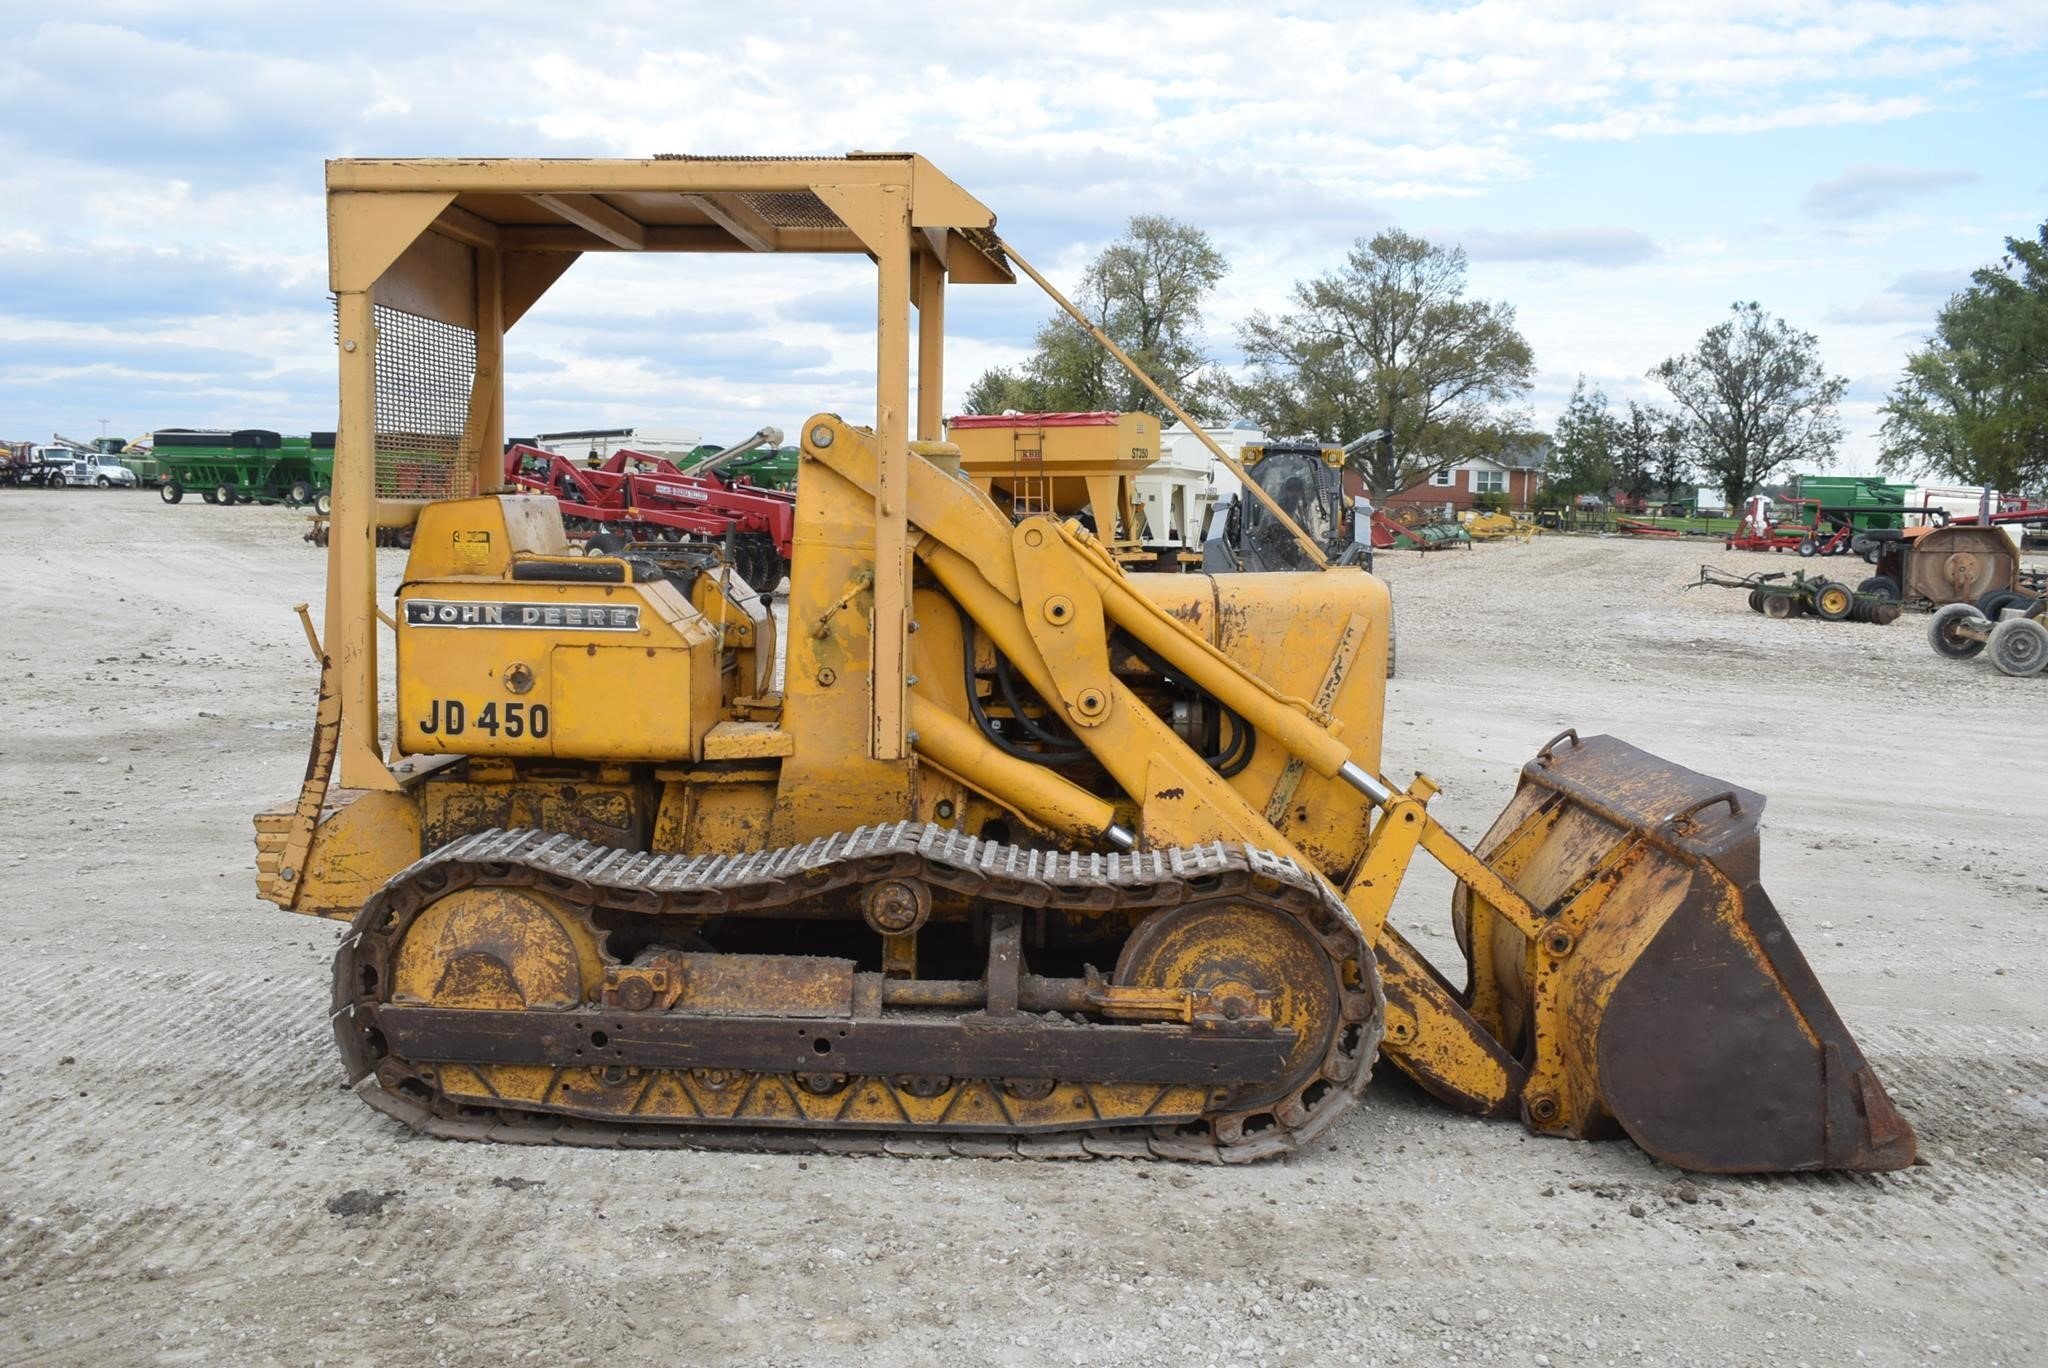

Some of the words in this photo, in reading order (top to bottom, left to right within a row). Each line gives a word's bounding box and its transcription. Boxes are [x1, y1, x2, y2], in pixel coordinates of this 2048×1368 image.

[420, 606, 502, 624] JOHN
[523, 607, 627, 625] DEERE
[420, 700, 464, 735] JD
[477, 702, 548, 738] 450
